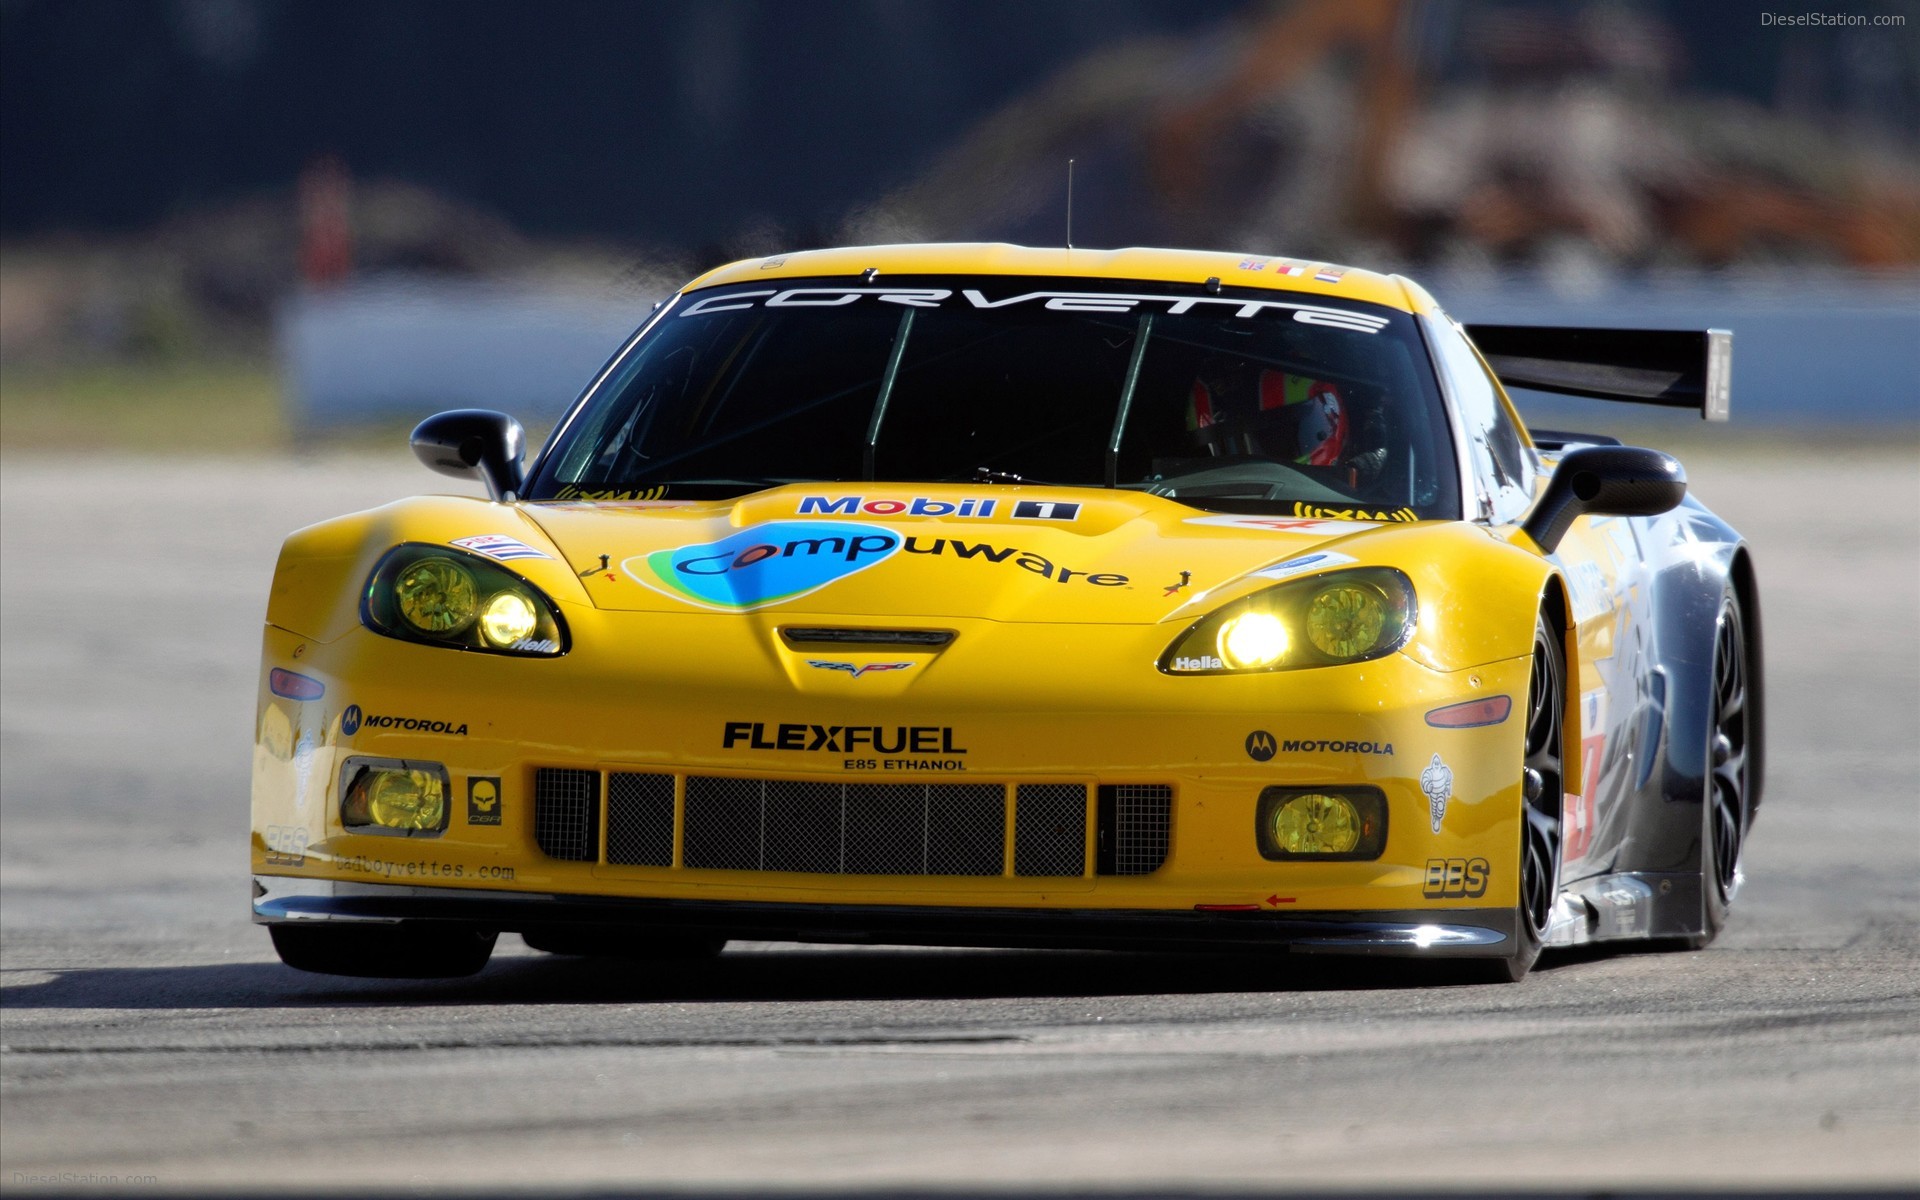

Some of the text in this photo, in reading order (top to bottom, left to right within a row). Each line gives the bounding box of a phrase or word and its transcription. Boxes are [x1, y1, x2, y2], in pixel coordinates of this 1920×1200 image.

[679, 287, 1390, 334] CORVETTE
[797, 495, 998, 519] Mobil
[511, 637, 560, 653] Hella
[1175, 655, 1223, 670] Hella
[364, 714, 469, 736] MOTOROLA
[722, 721, 968, 754] FLEXFUEL
[1281, 739, 1394, 756] MOTOROLA
[843, 759, 968, 771] E85 ETHANOL
[1421, 856, 1491, 899] BBS
